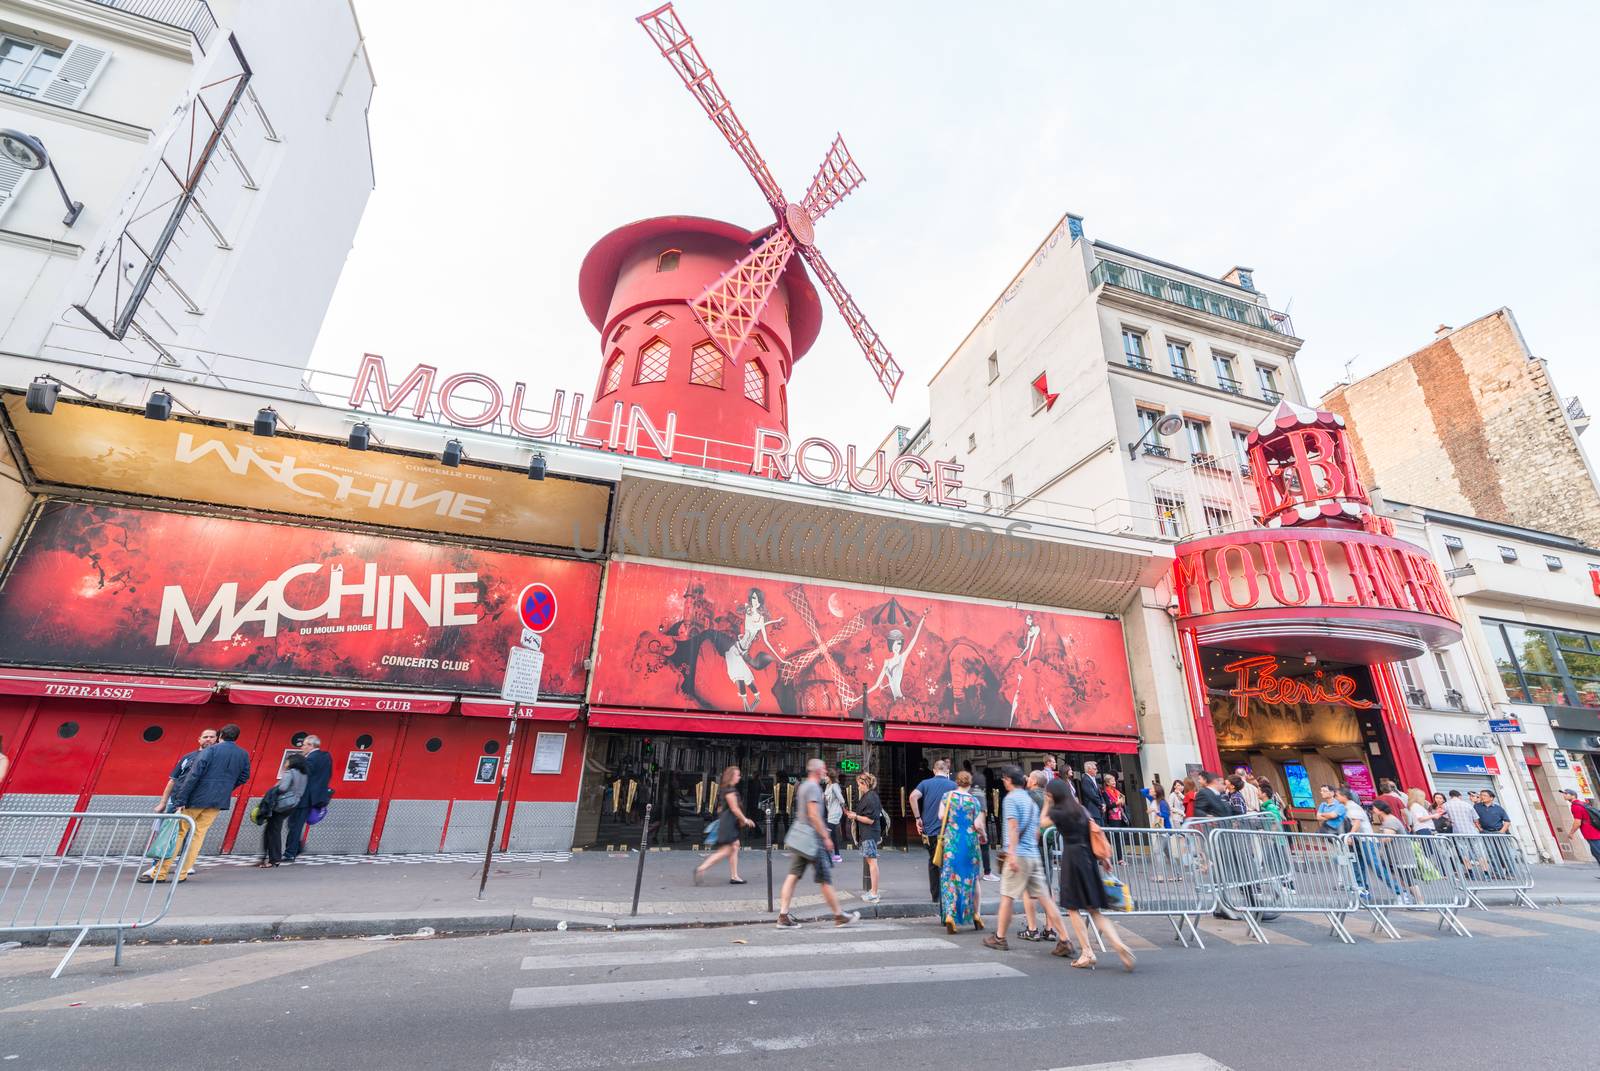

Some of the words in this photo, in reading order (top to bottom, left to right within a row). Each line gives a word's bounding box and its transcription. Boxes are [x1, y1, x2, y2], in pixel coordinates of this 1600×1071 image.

[349, 352, 676, 459] MOULIN
[753, 427, 967, 507] ROUGE
[331, 563, 344, 572] LA
[155, 562, 478, 646] MACHINE
[300, 627, 312, 635] DU
[314, 625, 345, 634] MOULIN
[347, 623, 373, 632] ROUGE
[381, 654, 439, 669] CONCERTS
[441, 660, 470, 671] CLUB
[45, 684, 134, 699] TERRASSE
[274, 694, 351, 708] CONCERTS
[375, 700, 411, 711] CLUB
